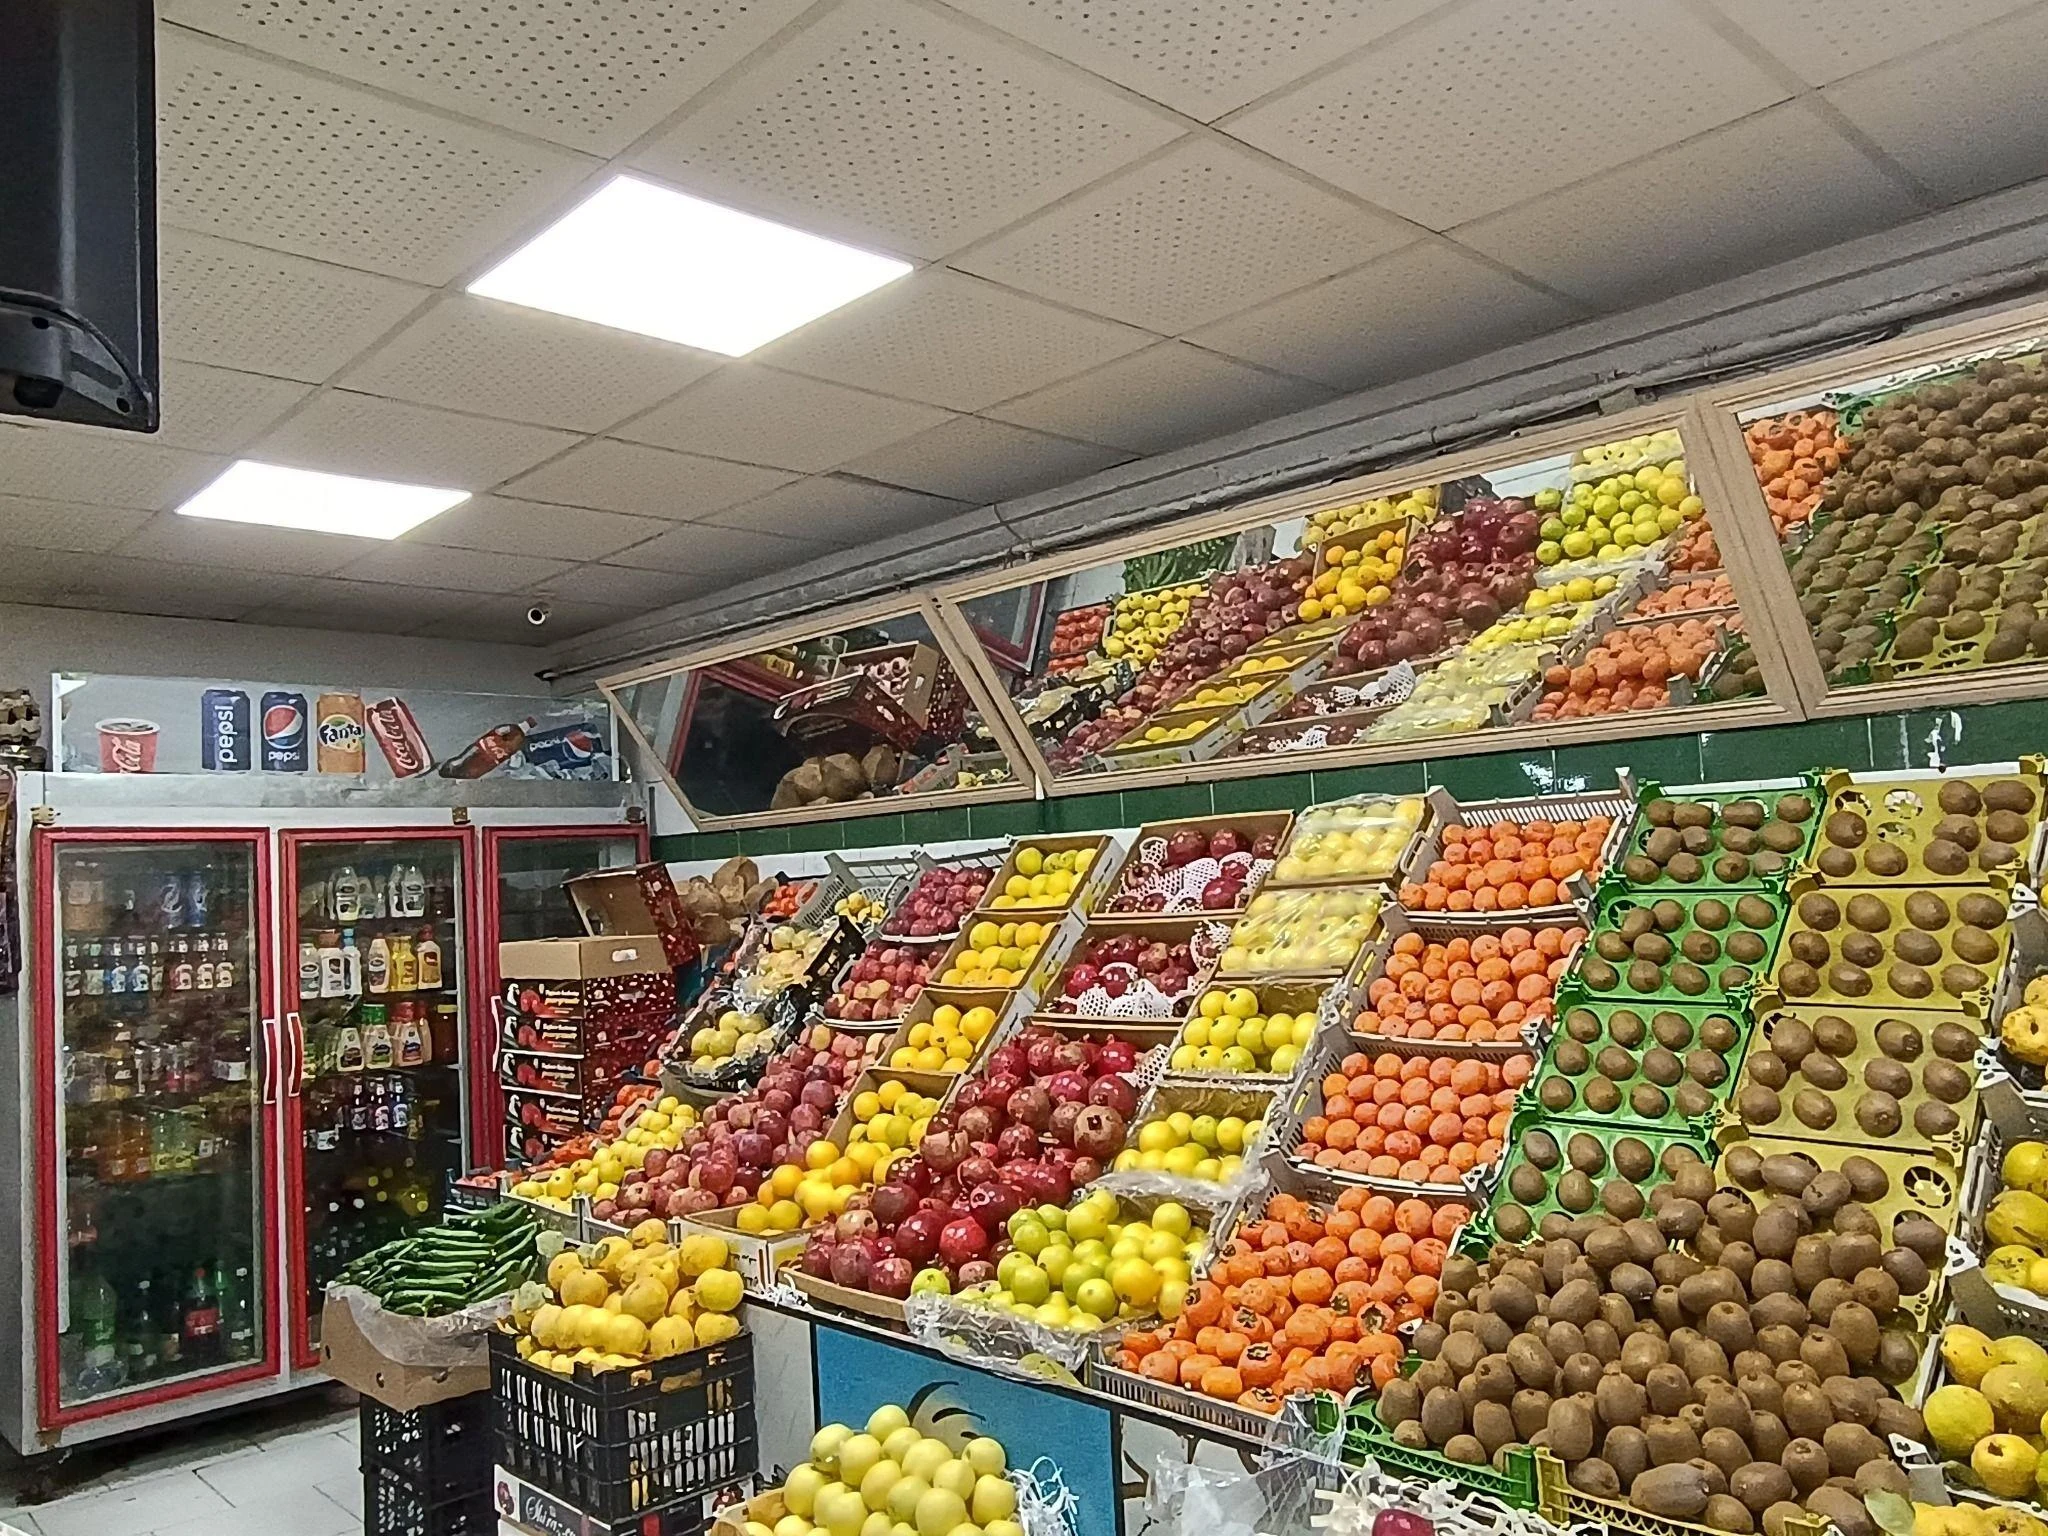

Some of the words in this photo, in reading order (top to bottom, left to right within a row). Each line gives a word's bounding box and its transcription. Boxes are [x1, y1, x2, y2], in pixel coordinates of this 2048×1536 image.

[215, 705, 237, 763] pepsi
[319, 723, 362, 745] Fanta
[268, 751, 300, 763] pepsi
